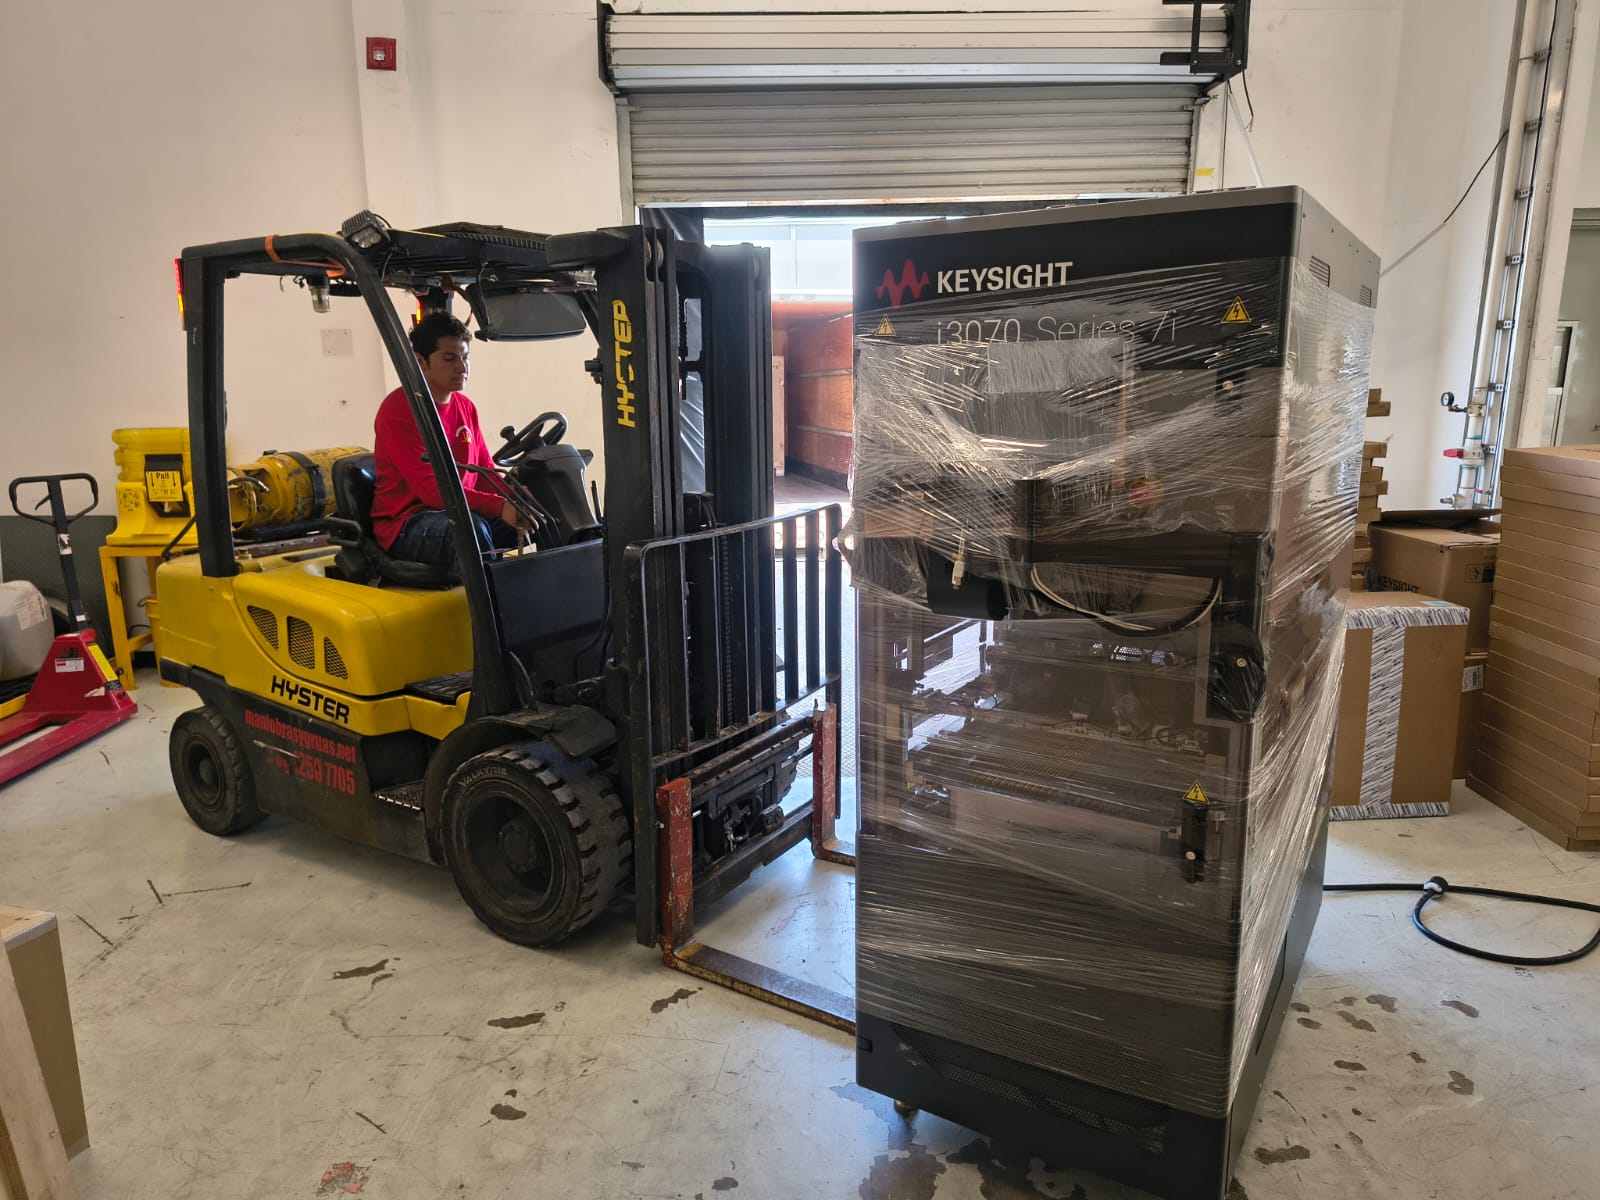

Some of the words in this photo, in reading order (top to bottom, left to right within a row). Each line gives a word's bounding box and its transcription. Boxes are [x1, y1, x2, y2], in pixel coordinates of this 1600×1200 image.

[937, 261, 1074, 294] KEYSIGHT
[936, 317, 1022, 345] i3070
[1036, 314, 1136, 344] Series
[1148, 309, 1178, 343] 7i
[270, 675, 351, 724] HYSTER
[244, 708, 357, 765] maniobrasygruas.net
[323, 761, 356, 796] 7705
